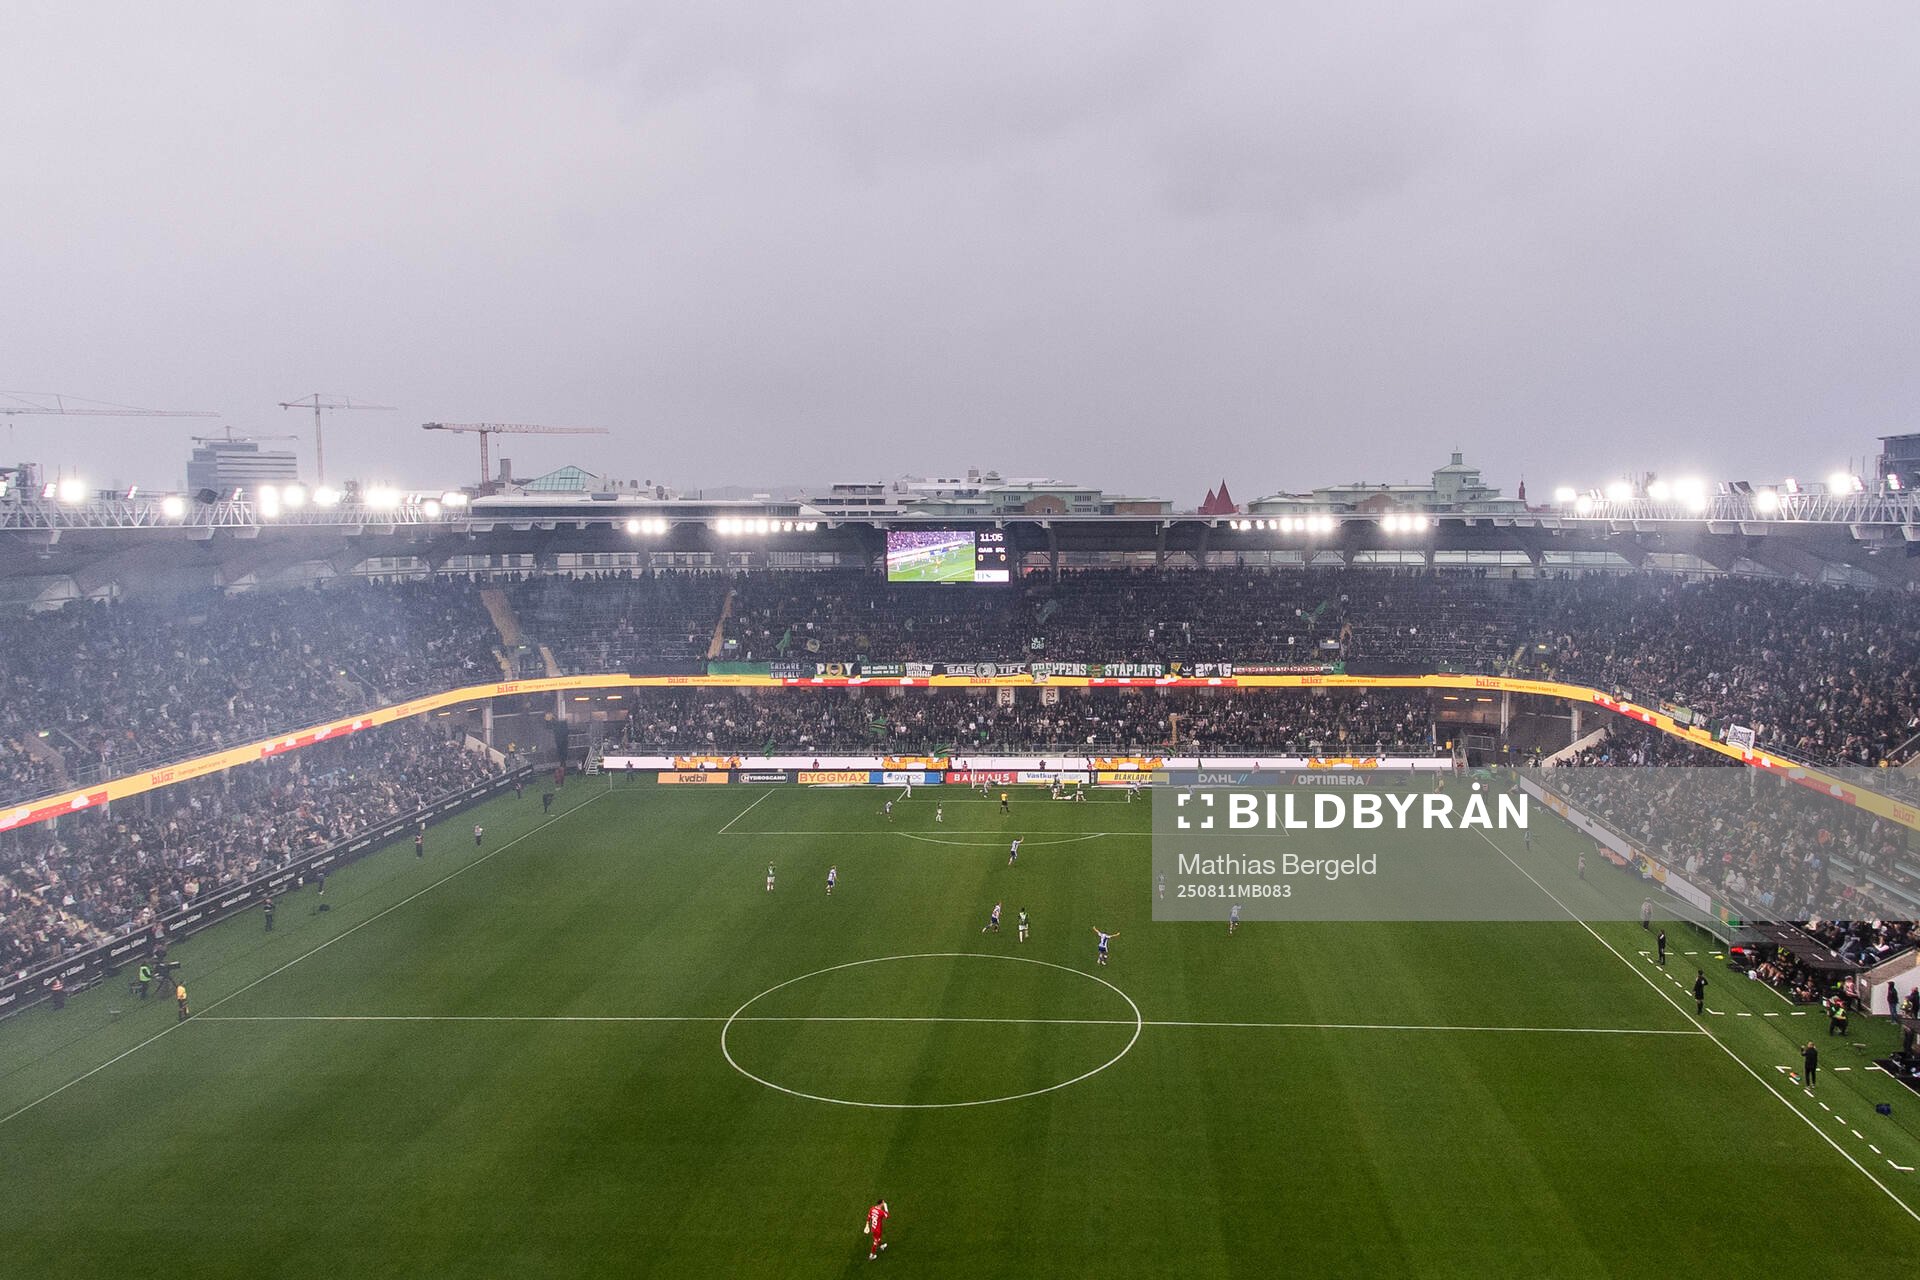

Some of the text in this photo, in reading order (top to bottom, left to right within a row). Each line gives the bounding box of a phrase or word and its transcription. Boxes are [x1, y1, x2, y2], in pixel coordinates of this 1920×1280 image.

[947, 665, 975, 674] GAIS
[679, 774, 707, 782] kvdbil
[800, 773, 866, 782] BYGGMAX
[954, 773, 1009, 781] BAUHAUS
[1198, 775, 1237, 783] DAHL
[1298, 776, 1364, 785] OPTIMERA
